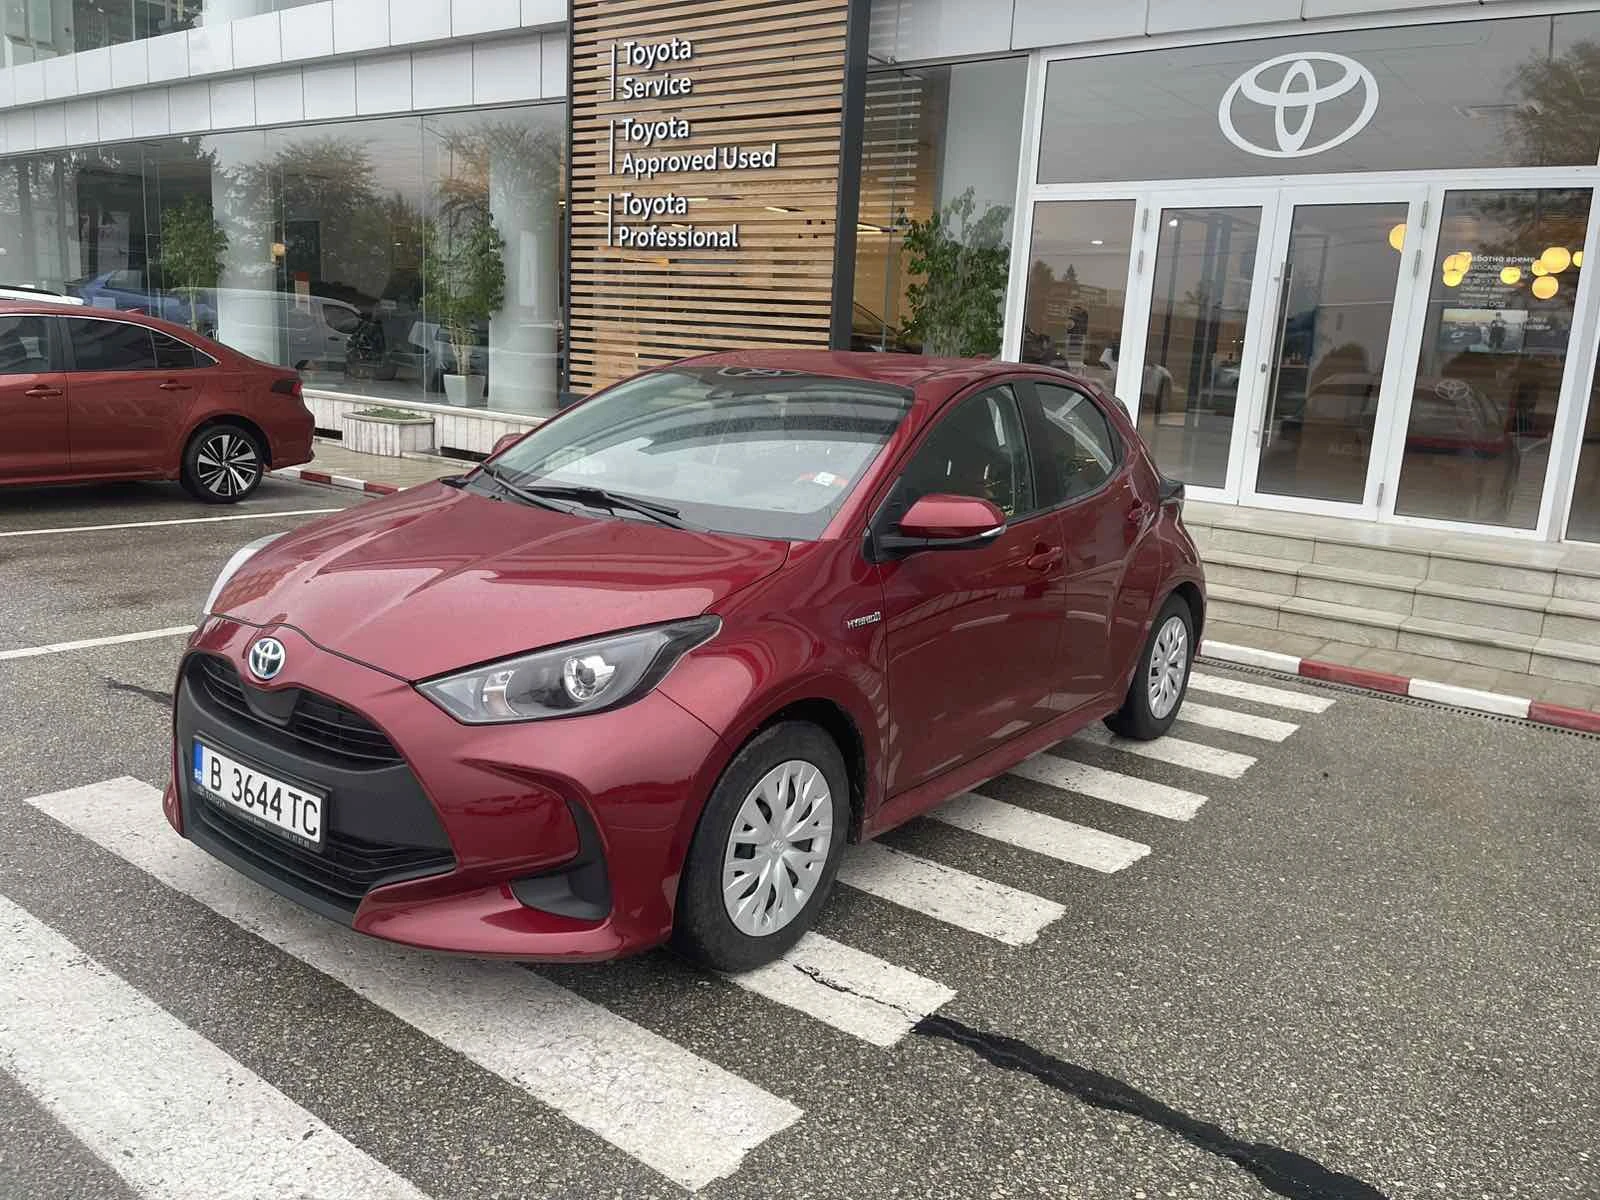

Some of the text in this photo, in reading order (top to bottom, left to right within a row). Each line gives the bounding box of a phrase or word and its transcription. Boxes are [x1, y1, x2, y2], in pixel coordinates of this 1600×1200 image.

[623, 37, 692, 69] Toyota
[622, 73, 692, 99] Service
[622, 116, 690, 146] Toyota
[621, 143, 777, 179] Approved Used
[620, 192, 688, 220] Toyota
[618, 224, 738, 248] Professional
[1468, 254, 1504, 264] аботно
[210, 756, 222, 791] B
[231, 768, 282, 822] 3644
[288, 791, 318, 836] TC
